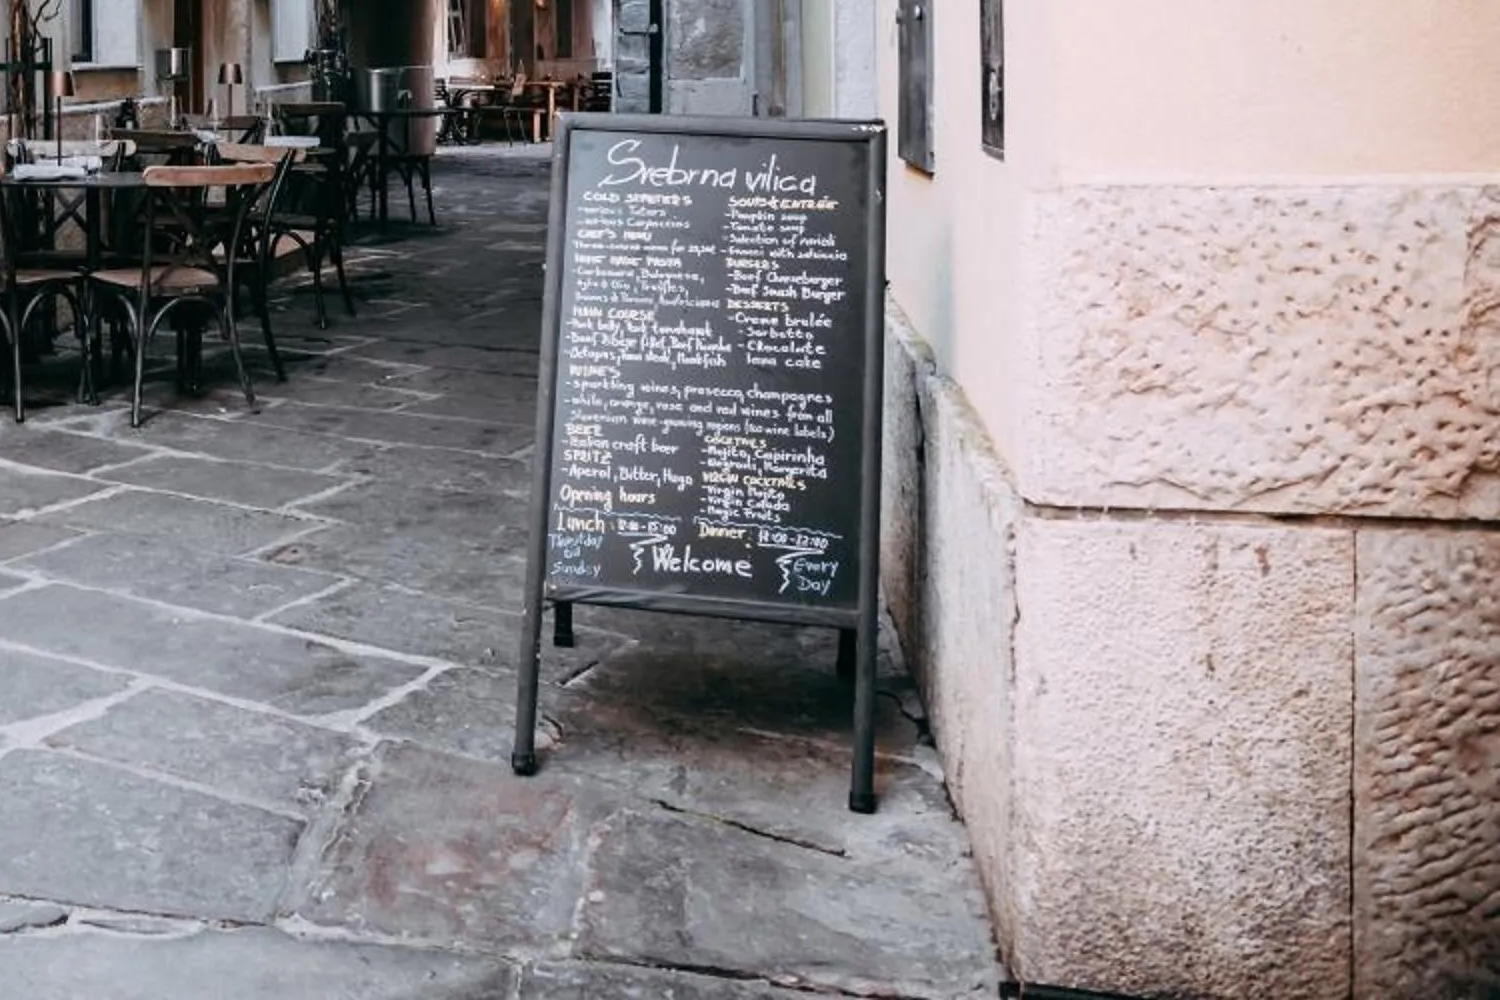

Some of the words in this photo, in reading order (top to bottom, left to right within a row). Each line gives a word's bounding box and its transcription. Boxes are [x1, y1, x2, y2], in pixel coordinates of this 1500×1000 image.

[597, 139, 737, 188] Srebrna
[745, 153, 816, 195] vilica
[582, 191, 620, 204] COLD
[780, 225, 805, 237] soup
[746, 381, 834, 411] champagnes
[689, 400, 713, 414] and
[715, 401, 738, 416] red
[740, 404, 781, 420] wines
[785, 403, 815, 423] from
[816, 408, 834, 424] all
[563, 448, 613, 465] SPRITZ
[754, 444, 826, 466] Caipirinha
[662, 466, 693, 492] Hugo
[619, 485, 657, 504] hours
[550, 560, 601, 578] Sunday
[652, 543, 754, 579] Welcome
[793, 558, 840, 578] Every
[796, 575, 831, 597] Day
